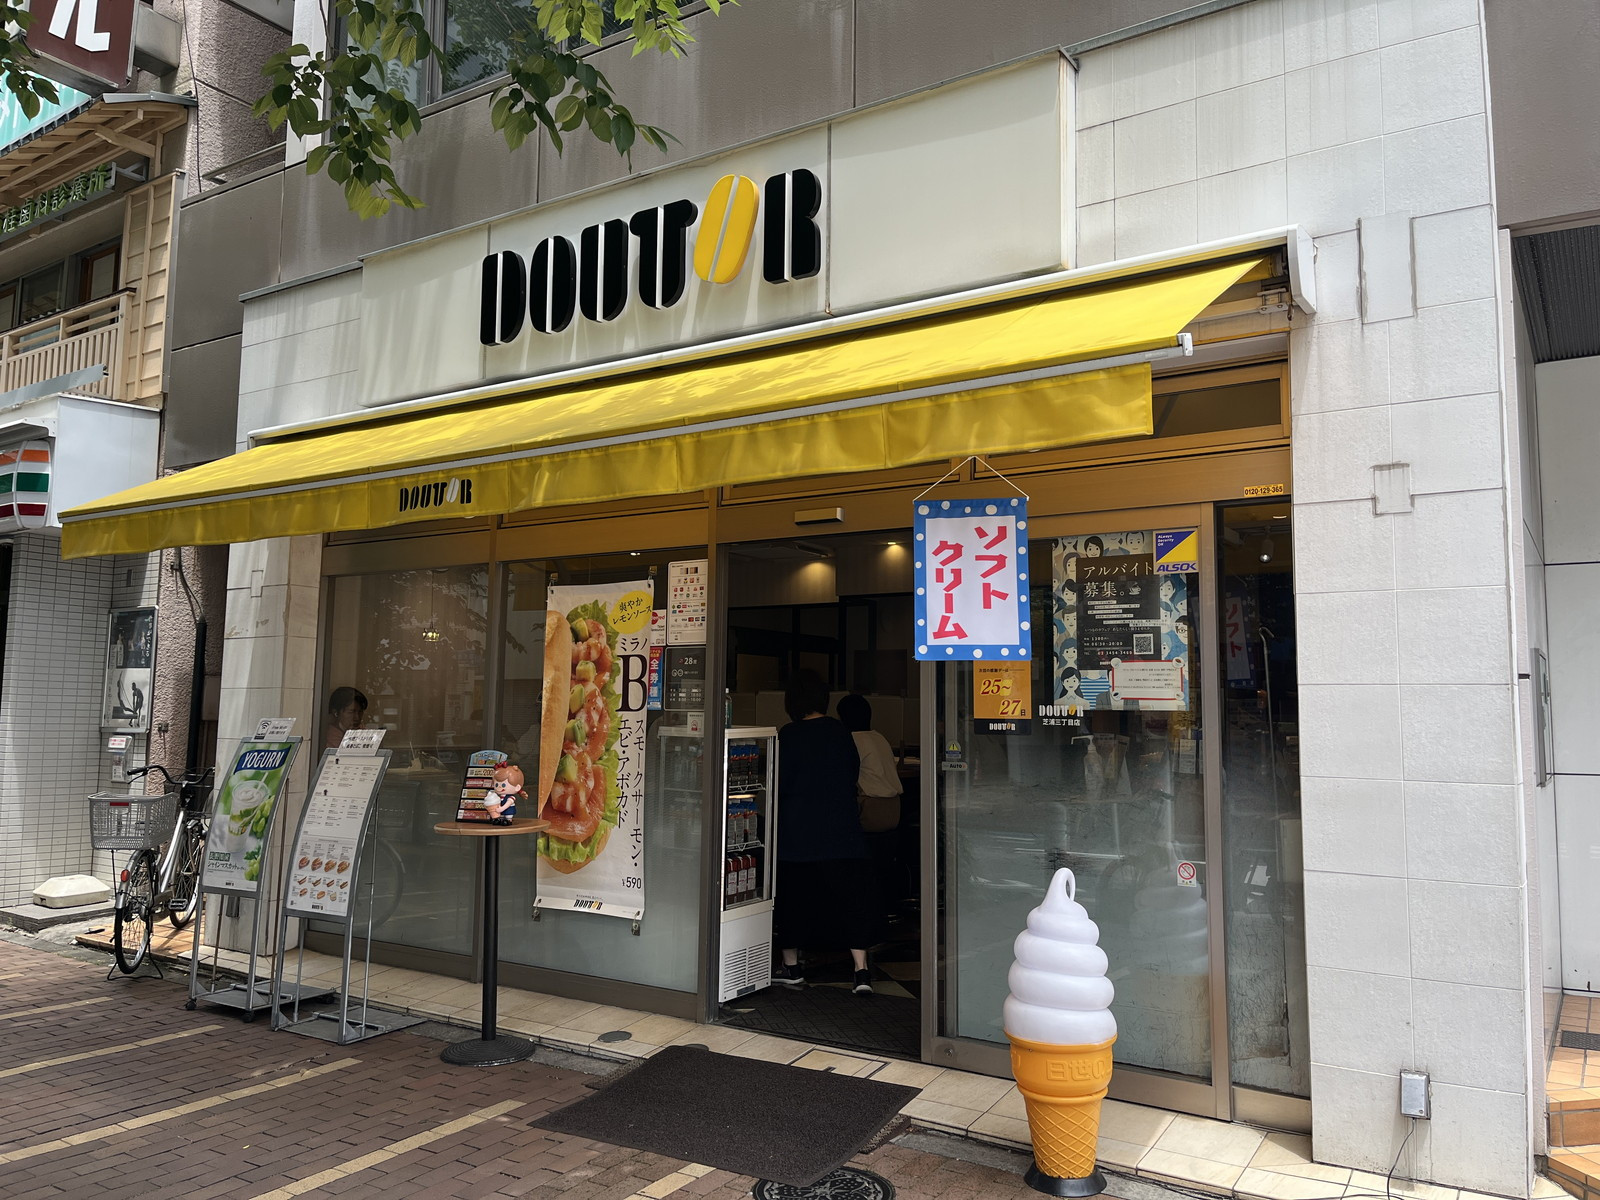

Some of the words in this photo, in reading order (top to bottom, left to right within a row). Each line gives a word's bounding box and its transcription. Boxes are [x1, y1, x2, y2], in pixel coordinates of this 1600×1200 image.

[480, 168, 822, 347] DOUTOR
[399, 478, 472, 513] DOUTOR
[1244, 486, 1283, 496] 0120-129-365
[974, 525, 1009, 610] ソフト
[1083, 561, 1152, 580] アルバイト
[1156, 562, 1197, 573] ALSOK
[931, 540, 969, 640] クリーム
[619, 597, 643, 613] 爽やか
[612, 605, 652, 625] レモンソース
[620, 637, 648, 652] ミラノ
[615, 654, 648, 712] B
[1038, 703, 1084, 718] DOUTOR
[989, 722, 1016, 731] DOUTOR
[1042, 718, 1081, 727] 芝浦三丁目店
[241, 751, 285, 769] YOGURN
[616, 718, 632, 829] エビ・アボカド
[622, 876, 642, 890] ¥590
[573, 899, 603, 911] DOUTOR
